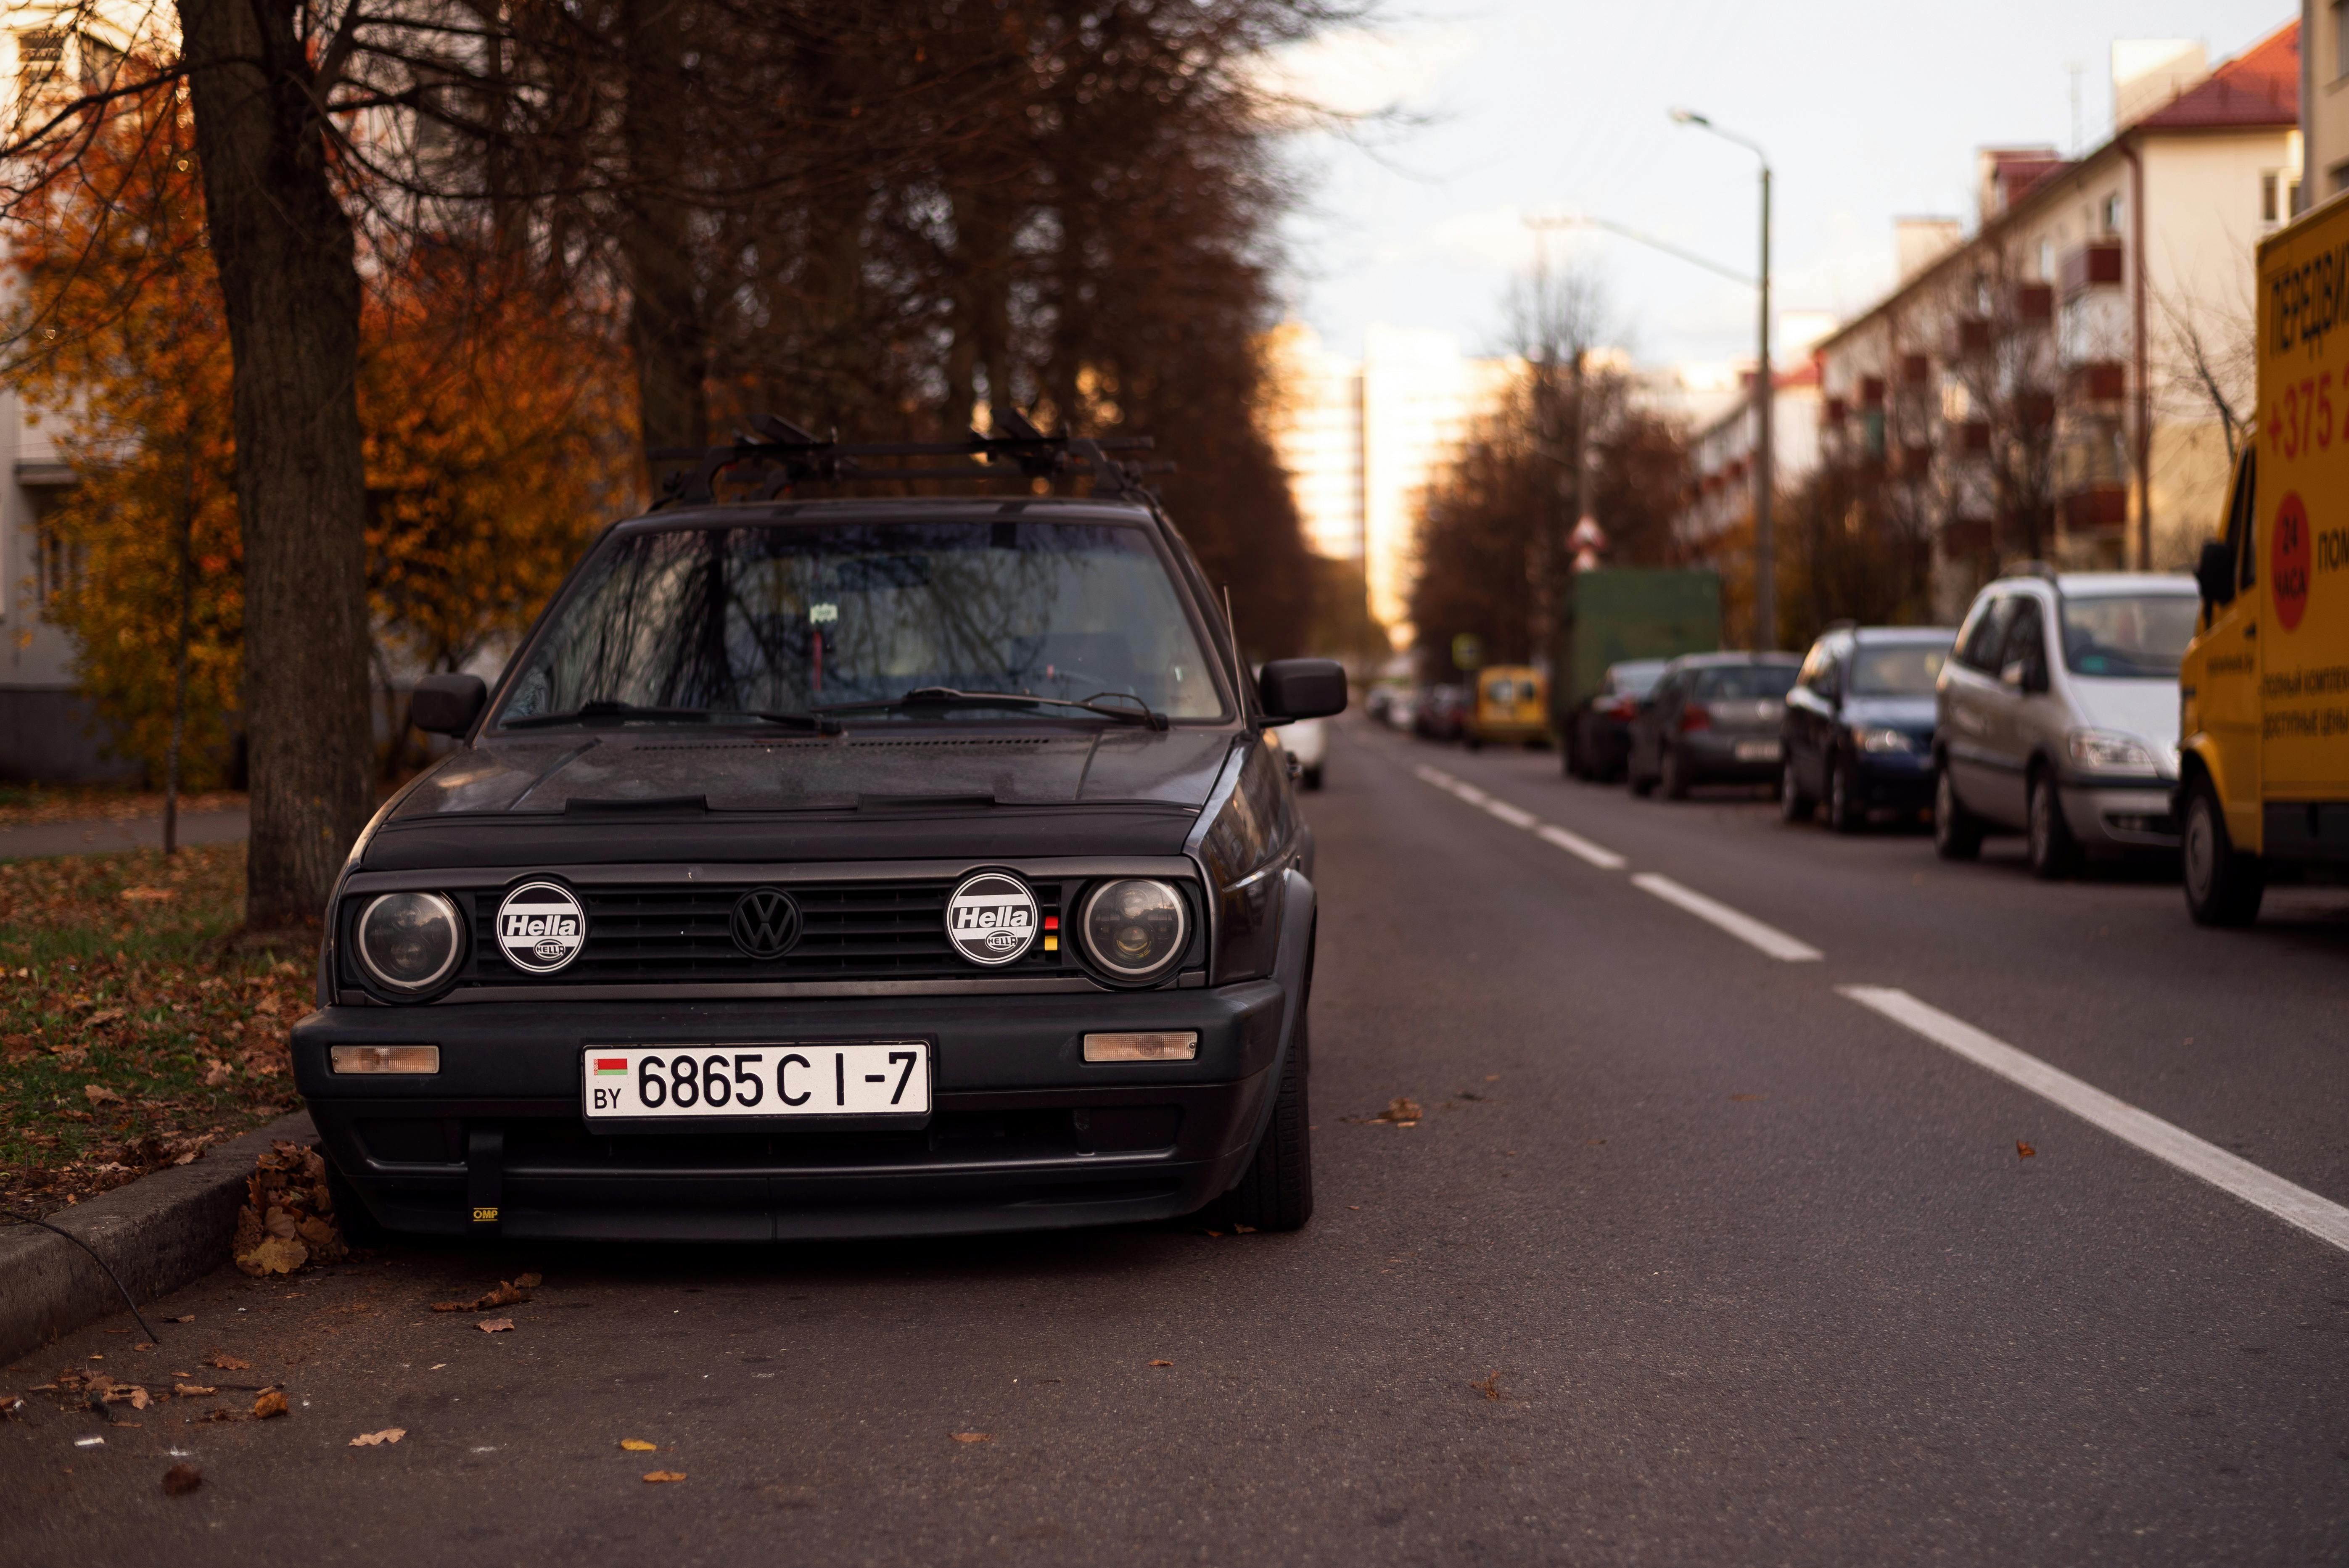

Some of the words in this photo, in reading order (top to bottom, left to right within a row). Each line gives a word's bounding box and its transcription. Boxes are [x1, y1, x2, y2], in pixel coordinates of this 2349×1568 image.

[2270, 240, 2349, 361] ПЕРЕДВИ
[2268, 371, 2333, 462] +375
[507, 915, 576, 936] Hella
[957, 906, 1028, 929] Hella
[536, 945, 565, 955] HELLA
[988, 936, 1017, 946] HELLA
[638, 1053, 764, 1108] 6865
[594, 1088, 621, 1109] BY
[473, 1209, 498, 1219] OMP
